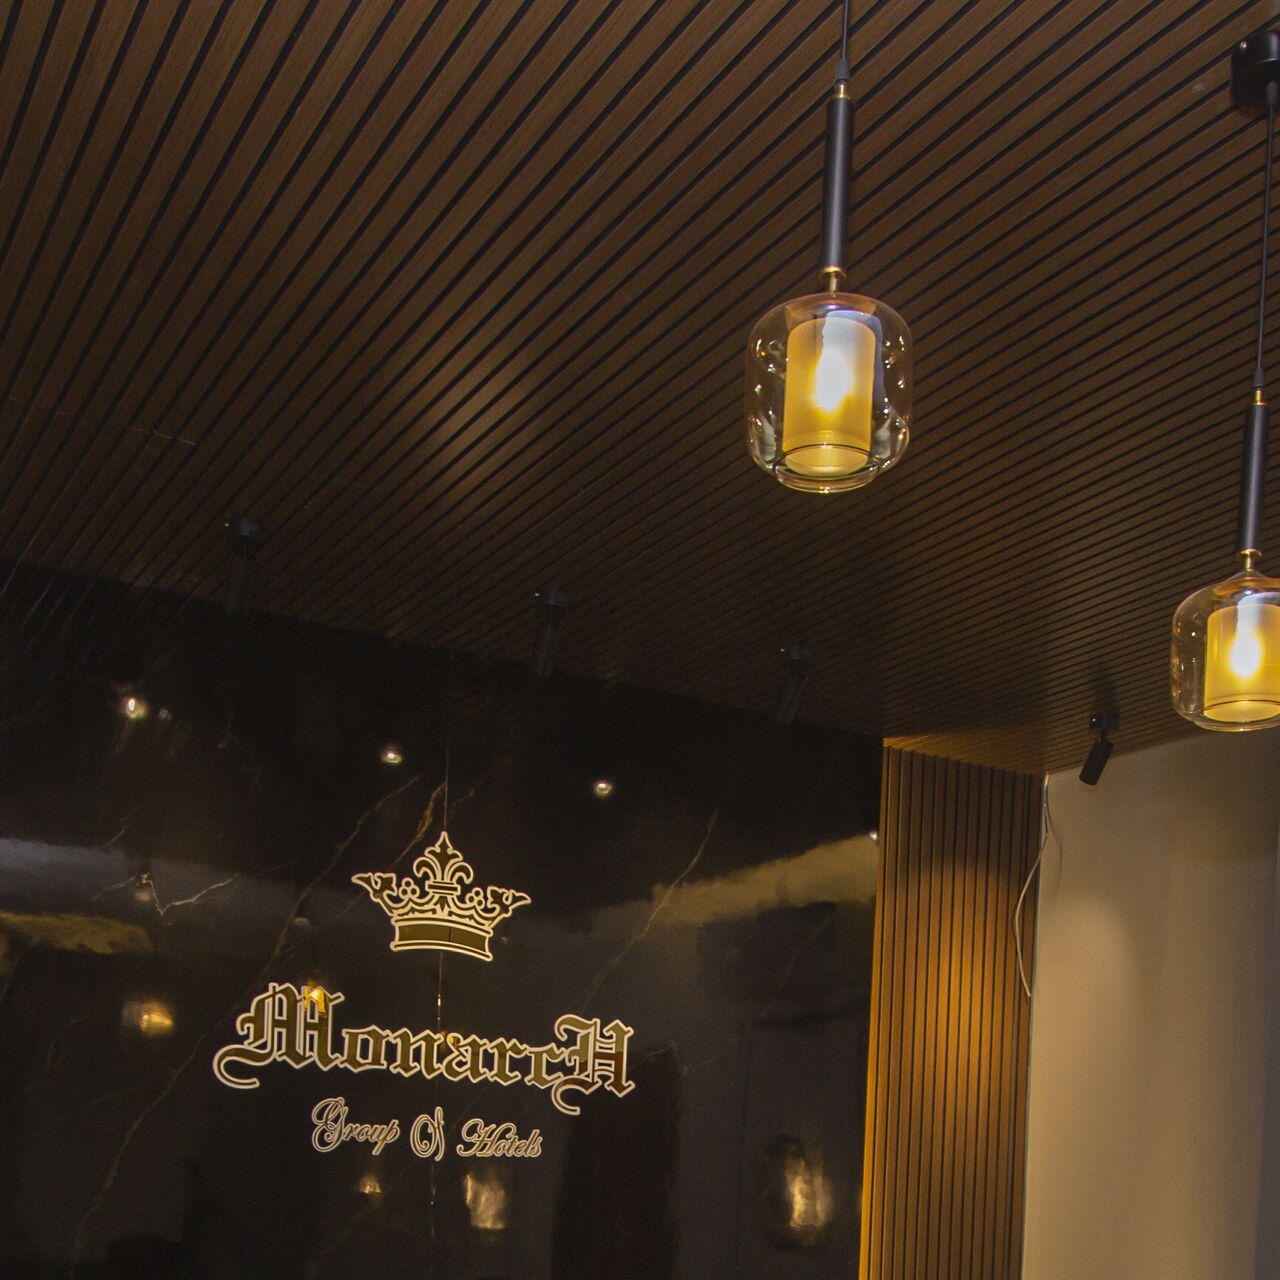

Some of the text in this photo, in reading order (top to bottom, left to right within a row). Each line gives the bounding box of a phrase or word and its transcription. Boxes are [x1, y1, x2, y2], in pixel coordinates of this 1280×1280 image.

[311, 1096, 544, 1162] Group Of Hotels
